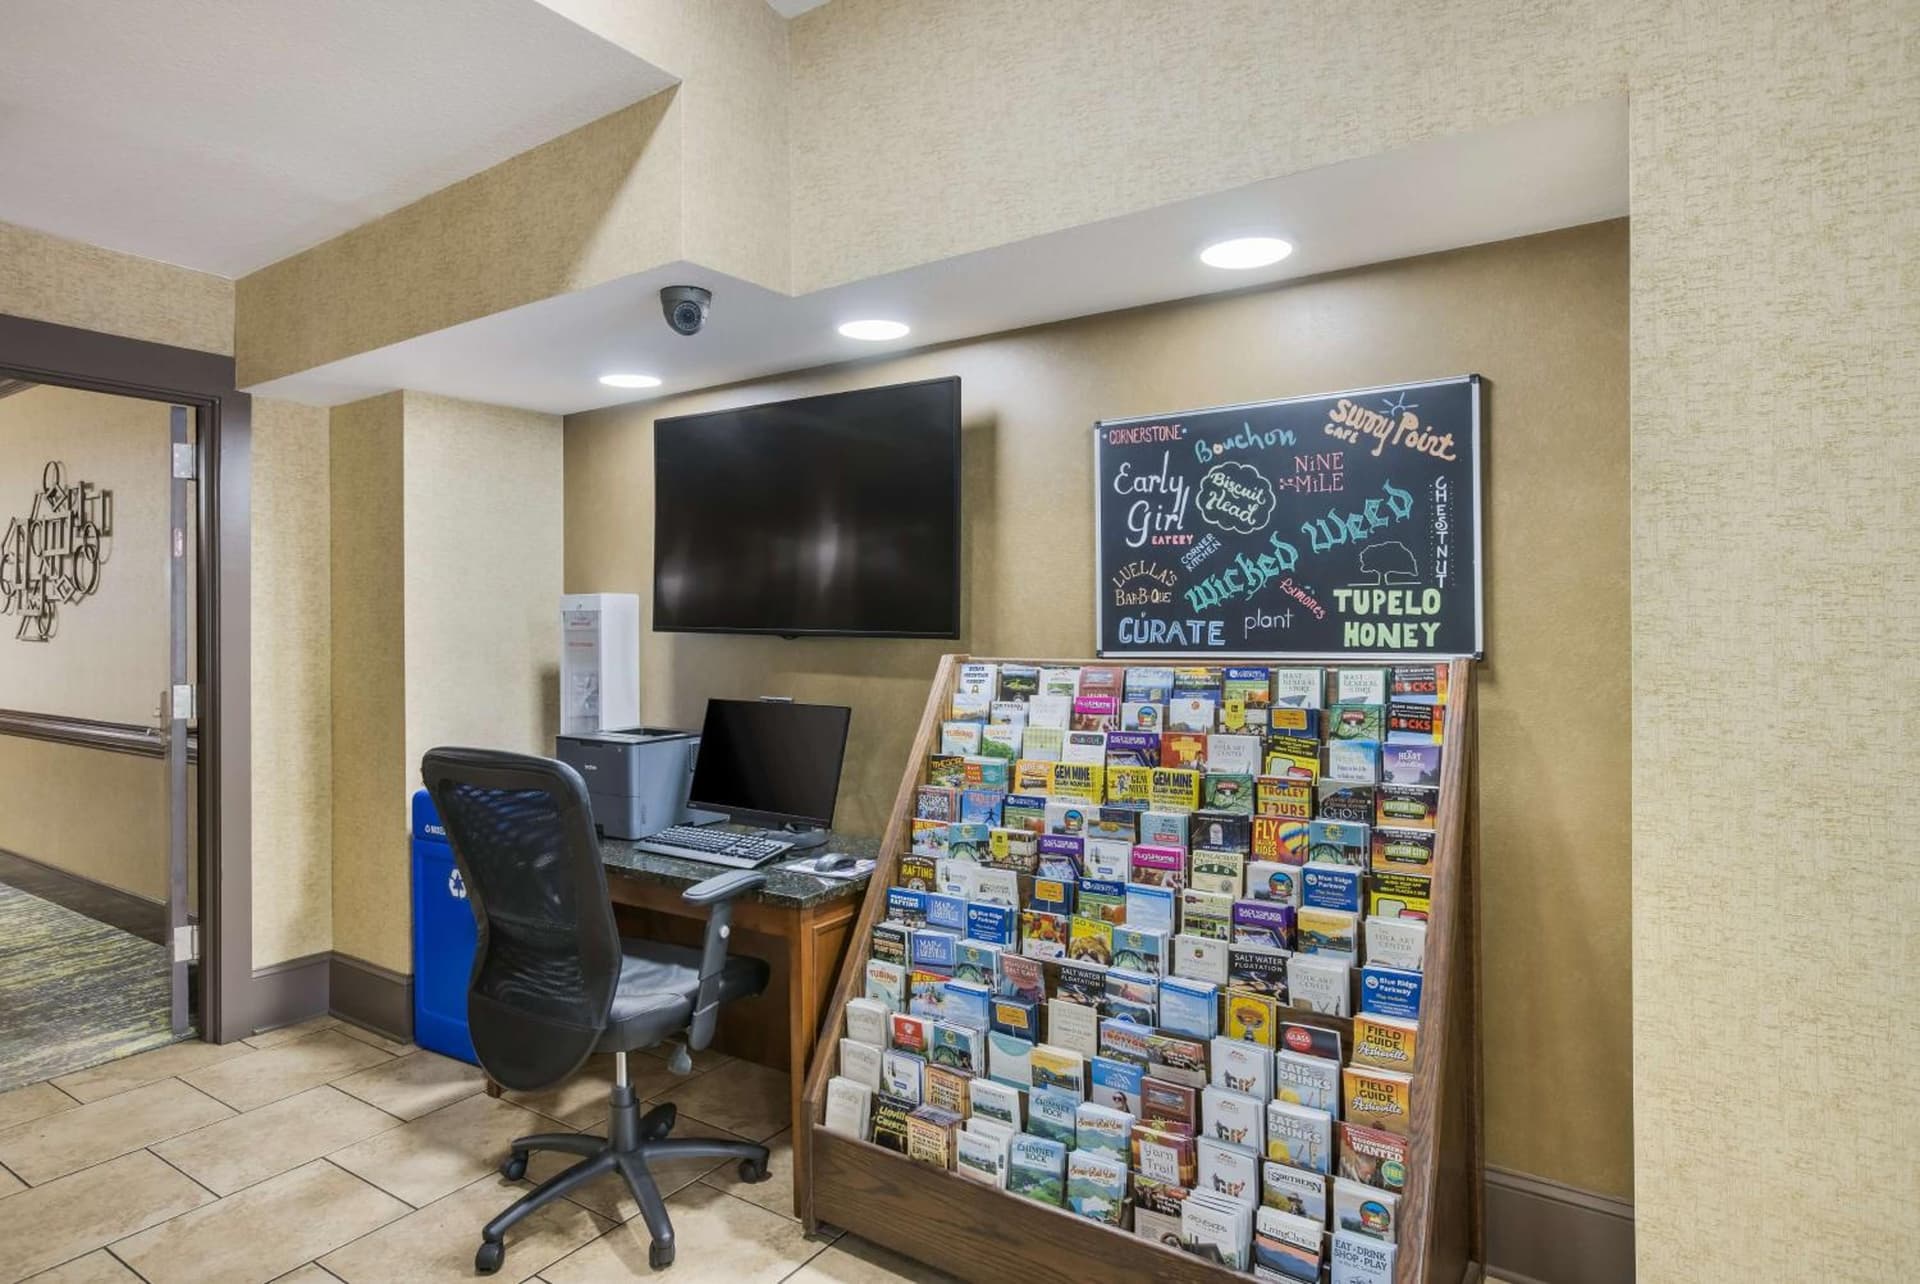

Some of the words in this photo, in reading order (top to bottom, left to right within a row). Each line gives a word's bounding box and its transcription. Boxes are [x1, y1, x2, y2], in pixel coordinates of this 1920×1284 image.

[1109, 425, 1183, 445] CORNERSTONE
[1324, 423, 1359, 444] CAFE
[1329, 399, 1395, 457] Sunny
[1392, 411, 1457, 462] Point
[1195, 422, 1296, 463] Bouchon
[1113, 450, 1184, 514] Early
[1211, 472, 1266, 505] Biscuit
[1205, 490, 1259, 525] Head
[1126, 486, 1190, 548] Girl
[1152, 533, 1194, 545] EATERY
[1434, 475, 1450, 589] CHESTNUT
[1180, 533, 1216, 566] CORNER
[1186, 541, 1223, 573] KITCHEN
[1112, 560, 1178, 589] LUELLA'S
[1333, 588, 1442, 616] TUPELO
[1244, 608, 1295, 641] plant
[1343, 621, 1442, 648] HONEY
[1054, 766, 1070, 780] GEM
[1072, 766, 1090, 780] MINE
[1153, 771, 1171, 786] GEM
[1172, 771, 1192, 787] MINE
[1264, 786, 1304, 798] TROLLEY
[1263, 802, 1306, 816] TOURS
[1256, 820, 1278, 840] FLY
[902, 864, 934, 879] RAFTING
[1234, 953, 1252, 962] SALT
[1255, 956, 1284, 966] WATER
[1234, 962, 1283, 972] FLOATATION
[1062, 968, 1077, 976] SALT
[1380, 984, 1411, 997] Parkway
[1398, 980, 1418, 990] Ridge
[1368, 1025, 1402, 1040] FIELD
[1366, 1035, 1400, 1050] GUIDE
[1279, 1061, 1310, 1076] EATS
[1280, 1072, 1332, 1090] DRINKS
[1360, 1080, 1394, 1094] FIELD
[1352, 1097, 1404, 1114] Asheville
[1359, 1090, 1394, 1104] GUIDE
[880, 1106, 906, 1121] Linvill
[1270, 1113, 1298, 1128] EATS
[1269, 1123, 1322, 1144] DRINKS
[1017, 1142, 1055, 1159] CHIMNEY
[1024, 1152, 1047, 1164] ROCK
[1352, 1141, 1404, 1162] WANTED
[1335, 1240, 1352, 1252] EAT
[1356, 1246, 1386, 1262] DRINK
[1334, 1248, 1359, 1263] SHOP
[1364, 1257, 1388, 1272] PLAY
